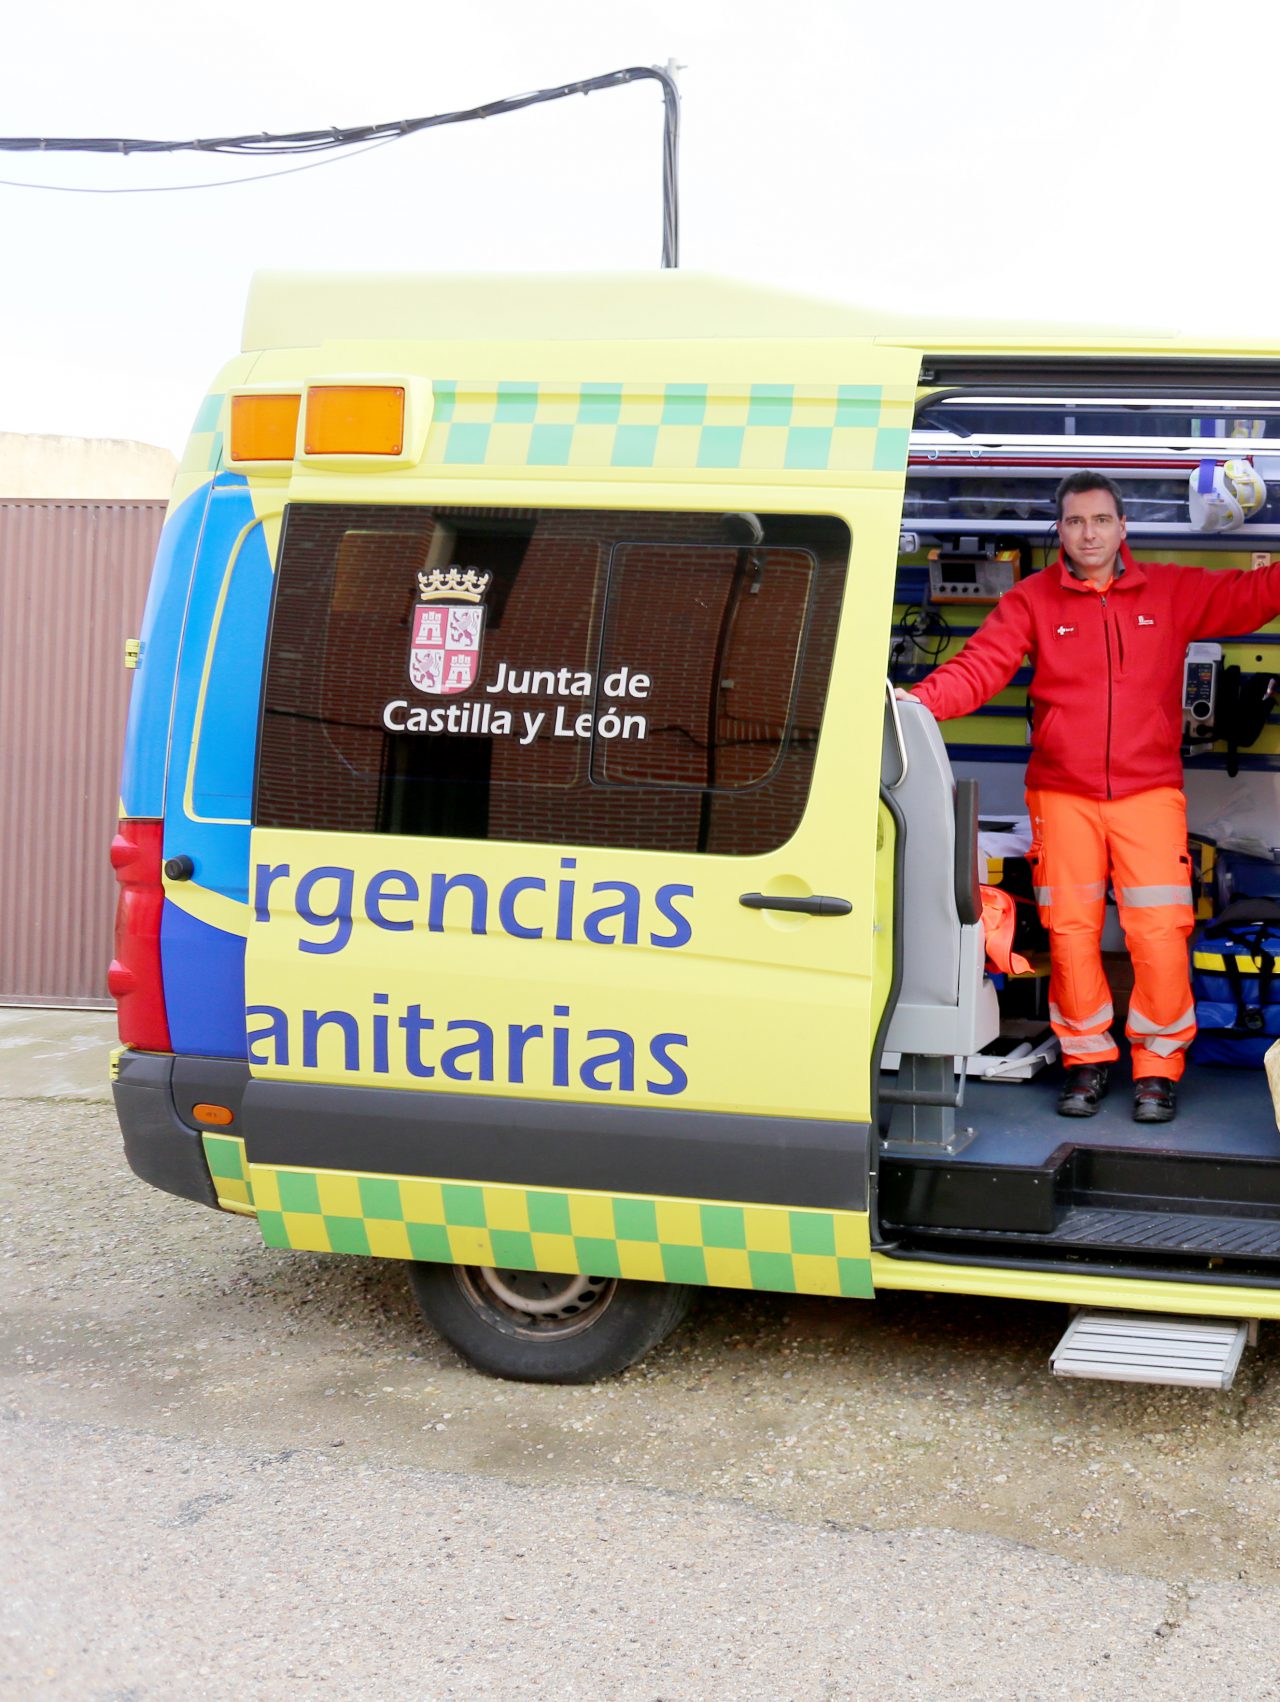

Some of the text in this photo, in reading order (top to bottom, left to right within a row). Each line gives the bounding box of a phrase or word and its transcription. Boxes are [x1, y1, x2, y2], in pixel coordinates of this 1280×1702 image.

[486, 663, 651, 698] Junta de
[383, 700, 647, 745] Castilla y León
[254, 857, 694, 954] rgencias
[246, 992, 688, 1096] anitarias
